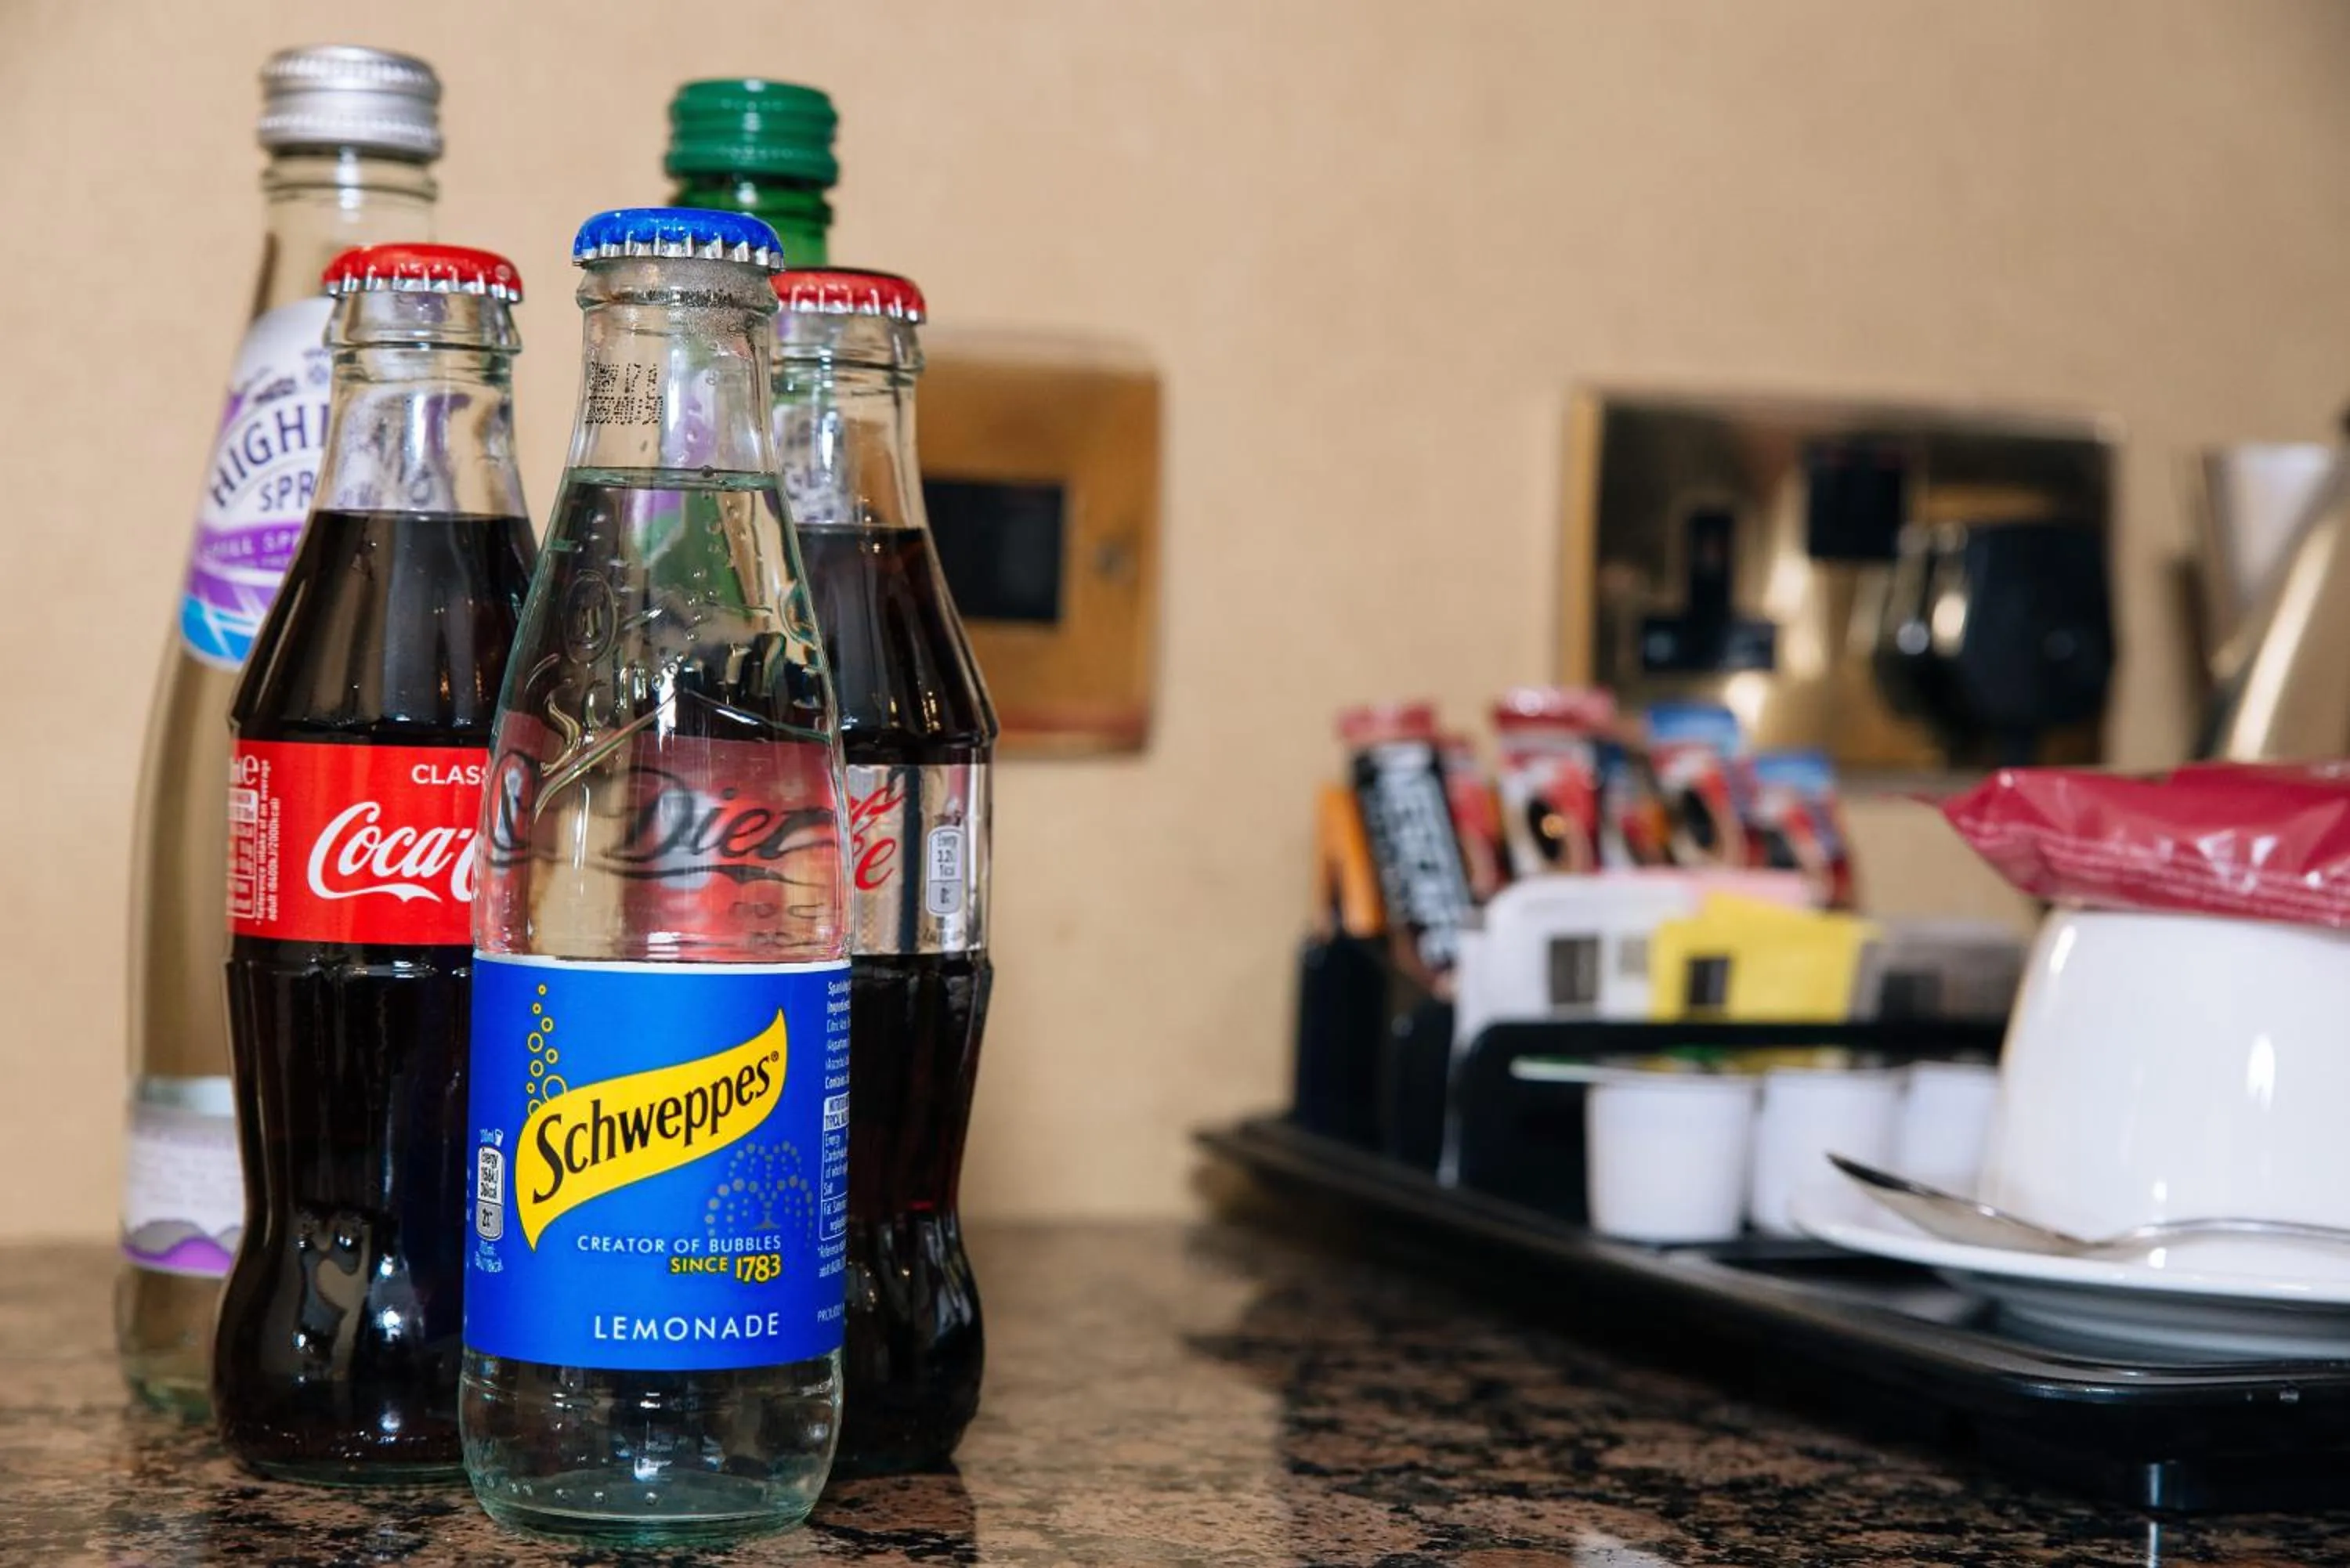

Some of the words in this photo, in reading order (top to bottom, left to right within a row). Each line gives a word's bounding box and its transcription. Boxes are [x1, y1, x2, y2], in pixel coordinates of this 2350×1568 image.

[533, 1057, 771, 1204] Schweppes
[577, 1235, 665, 1253] CREATOR
[674, 1238, 700, 1253] OF
[709, 1235, 781, 1253] BUBBLES
[671, 1256, 728, 1274] SINCE
[735, 1254, 781, 1282] 1783
[594, 1312, 779, 1342] LEMONADE
